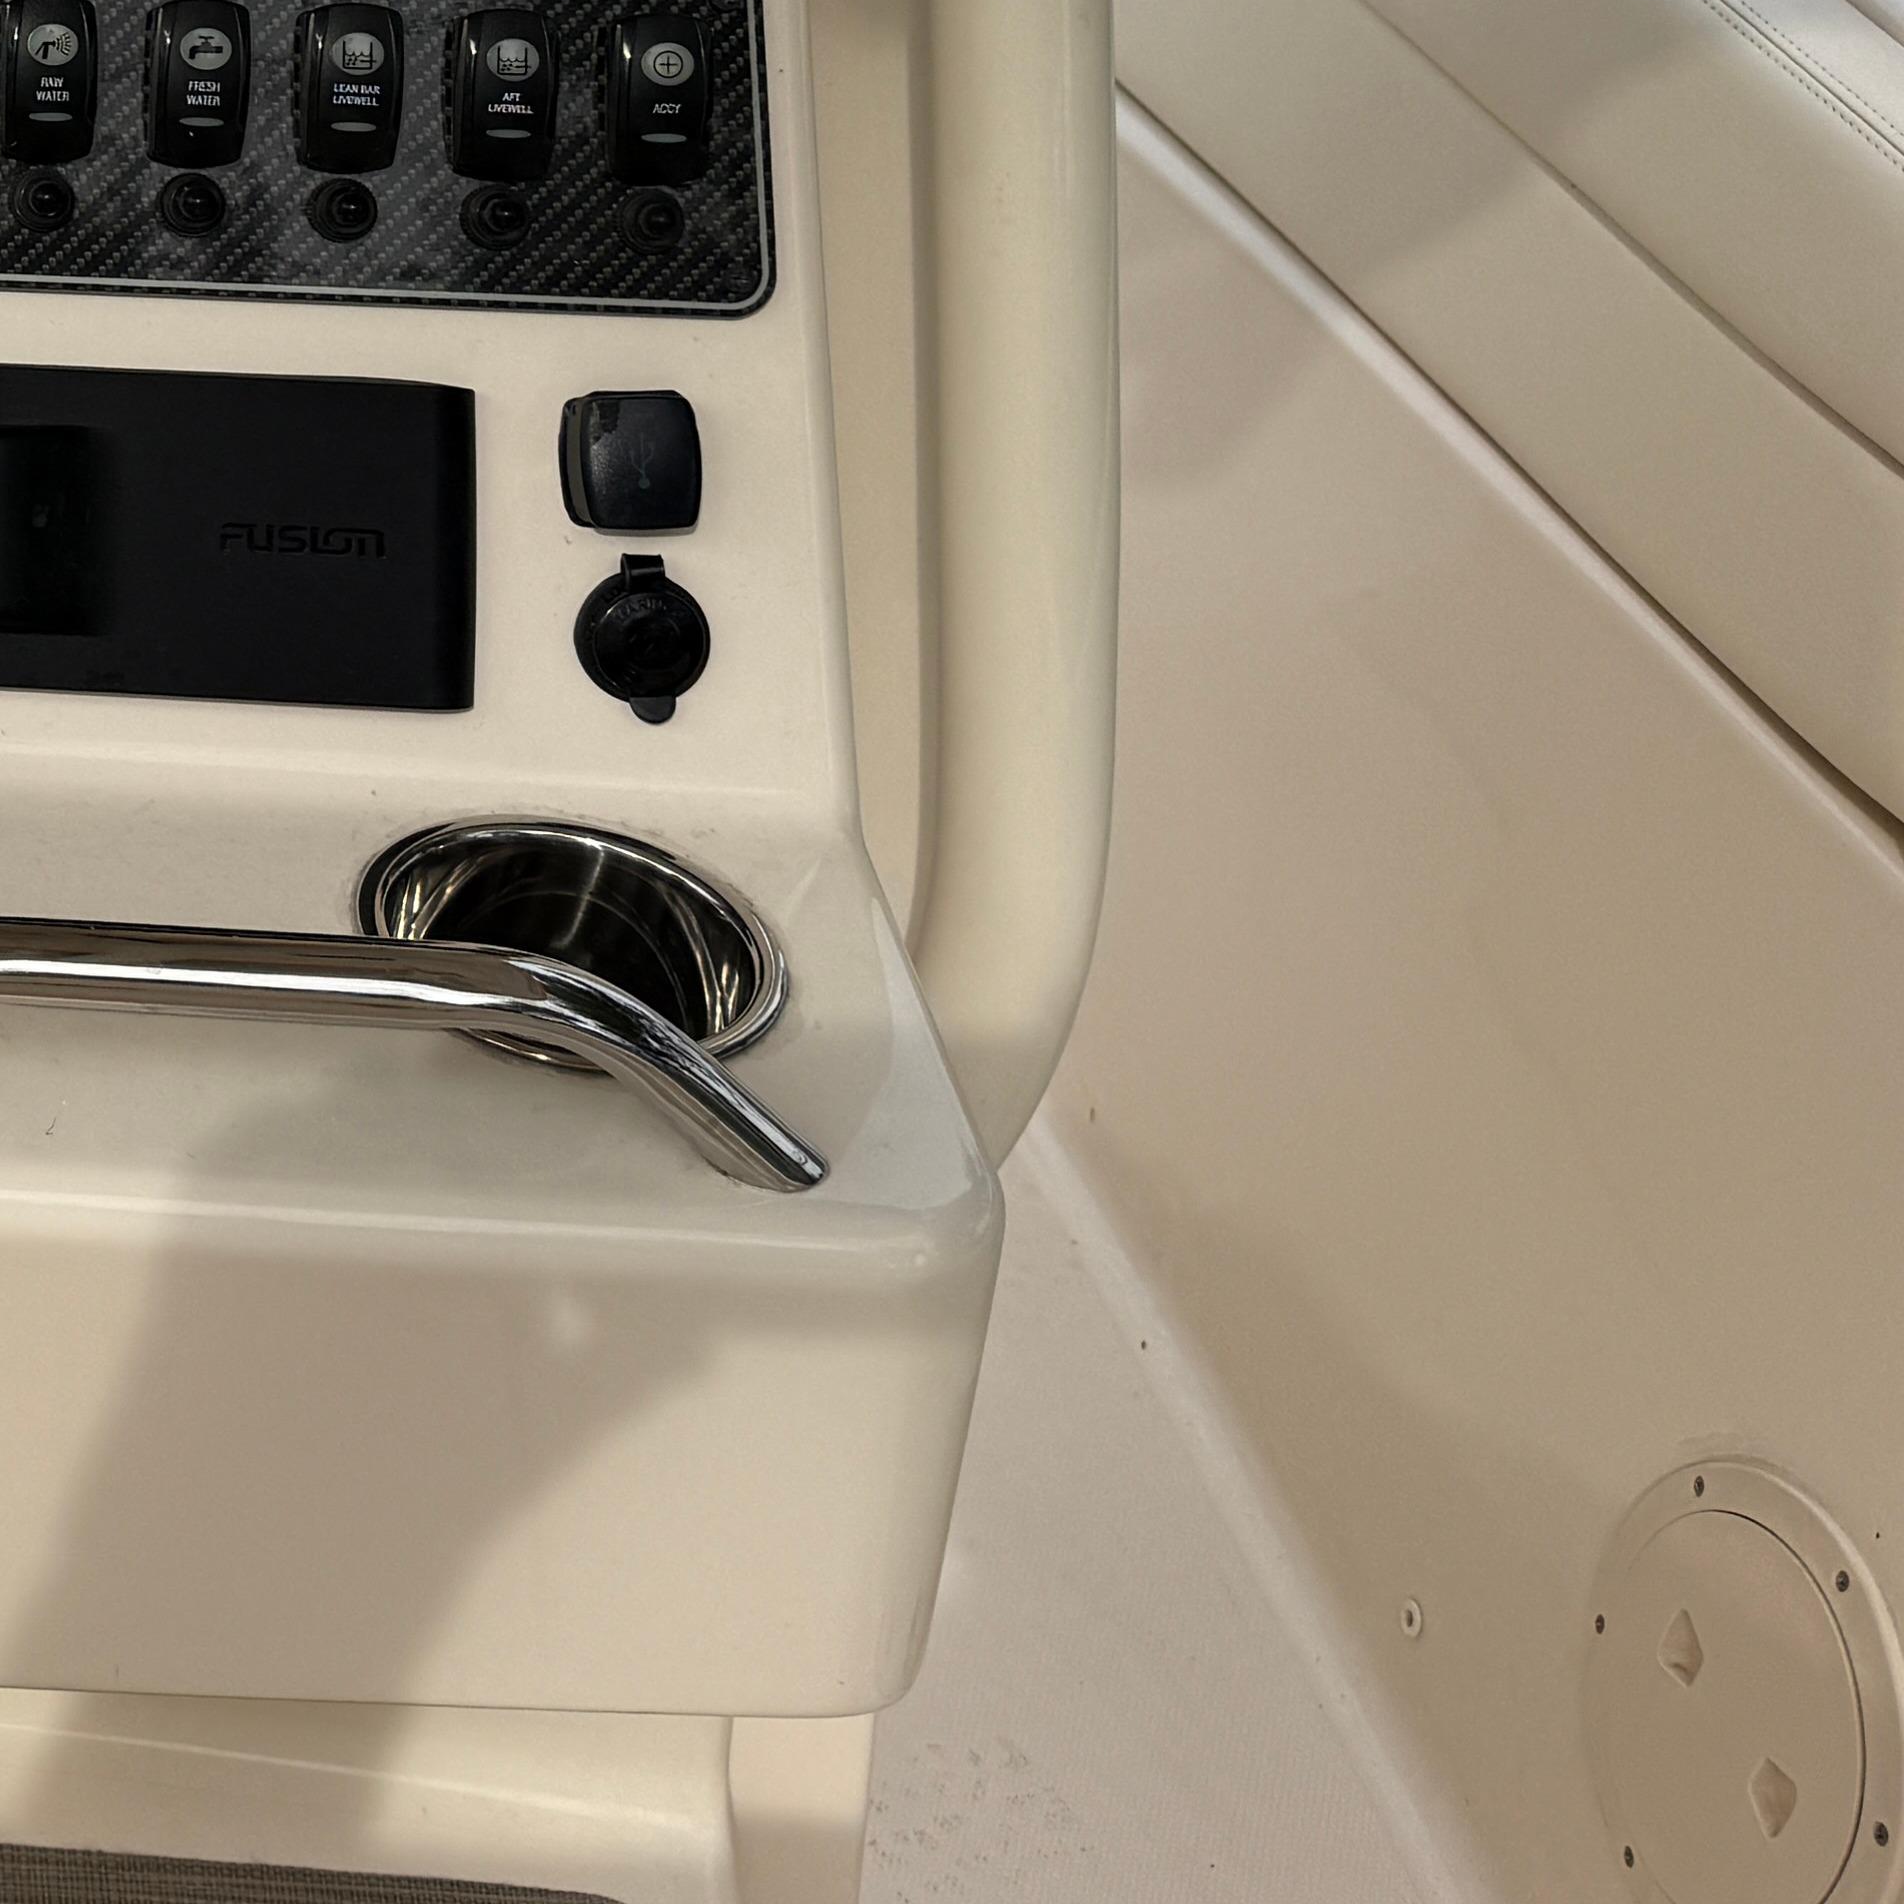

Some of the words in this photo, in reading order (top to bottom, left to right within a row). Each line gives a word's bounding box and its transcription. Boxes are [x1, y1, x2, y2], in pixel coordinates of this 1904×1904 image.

[36, 91, 70, 102] WATER
[186, 95, 220, 106] WATER
[502, 92, 520, 102] AFT
[219, 521, 386, 558] FUSION
